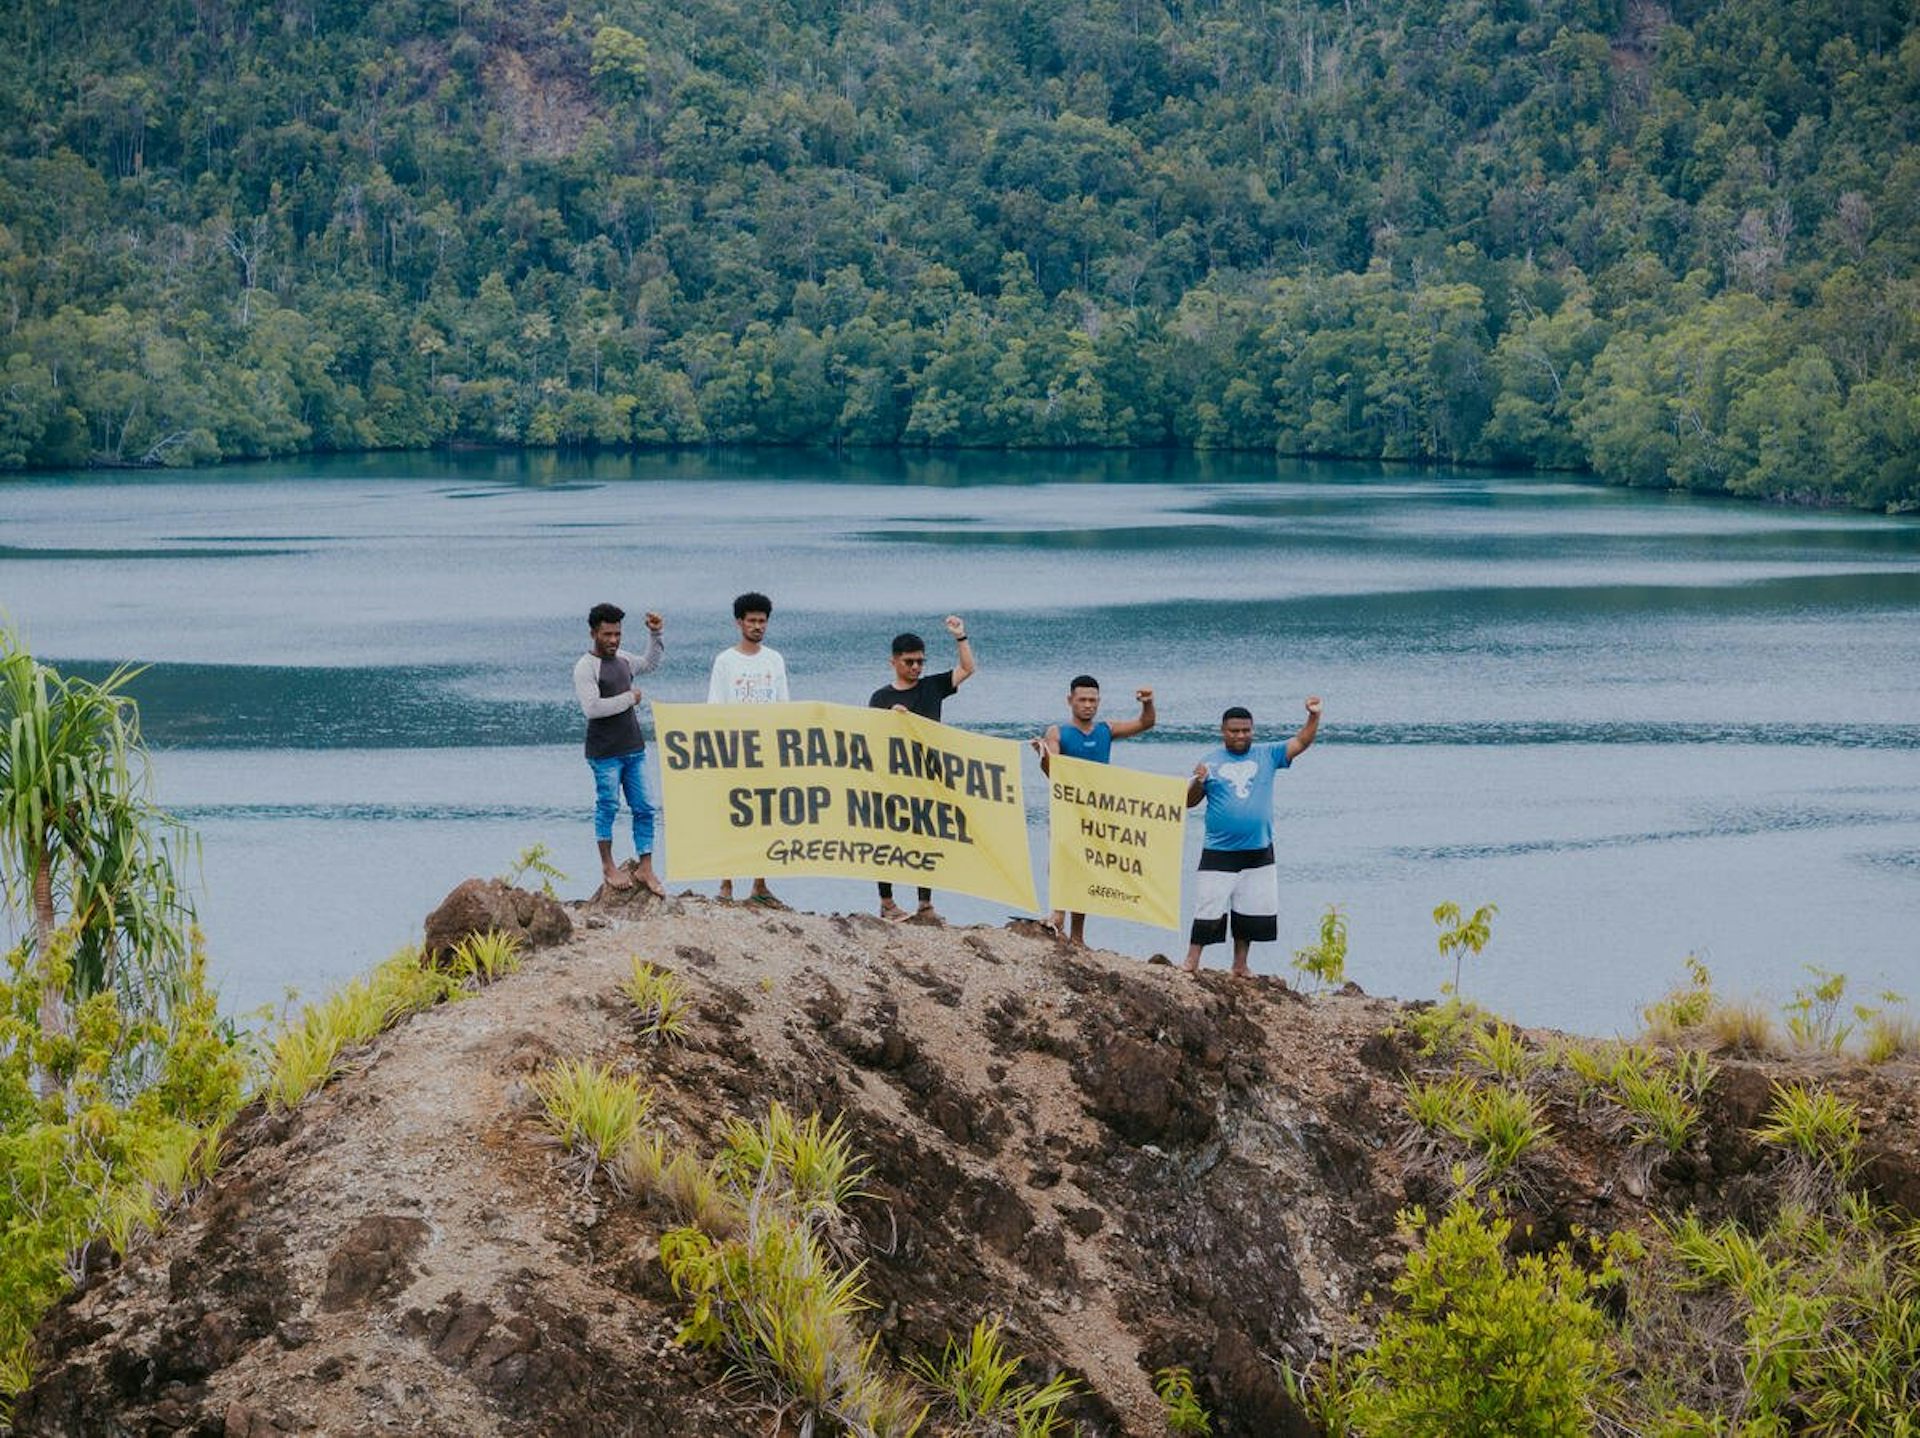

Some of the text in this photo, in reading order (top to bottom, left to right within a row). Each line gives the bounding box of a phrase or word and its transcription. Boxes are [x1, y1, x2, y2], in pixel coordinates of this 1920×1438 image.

[665, 728, 1016, 804] SAVE RAJA AMPAT:
[729, 787, 974, 844] STOP NICKEL
[1053, 784, 1182, 823] SELAMATKAN
[1081, 819, 1147, 848] HUTAN
[766, 839, 943, 872] GREENPEACE
[1085, 848, 1143, 876] PAPUA
